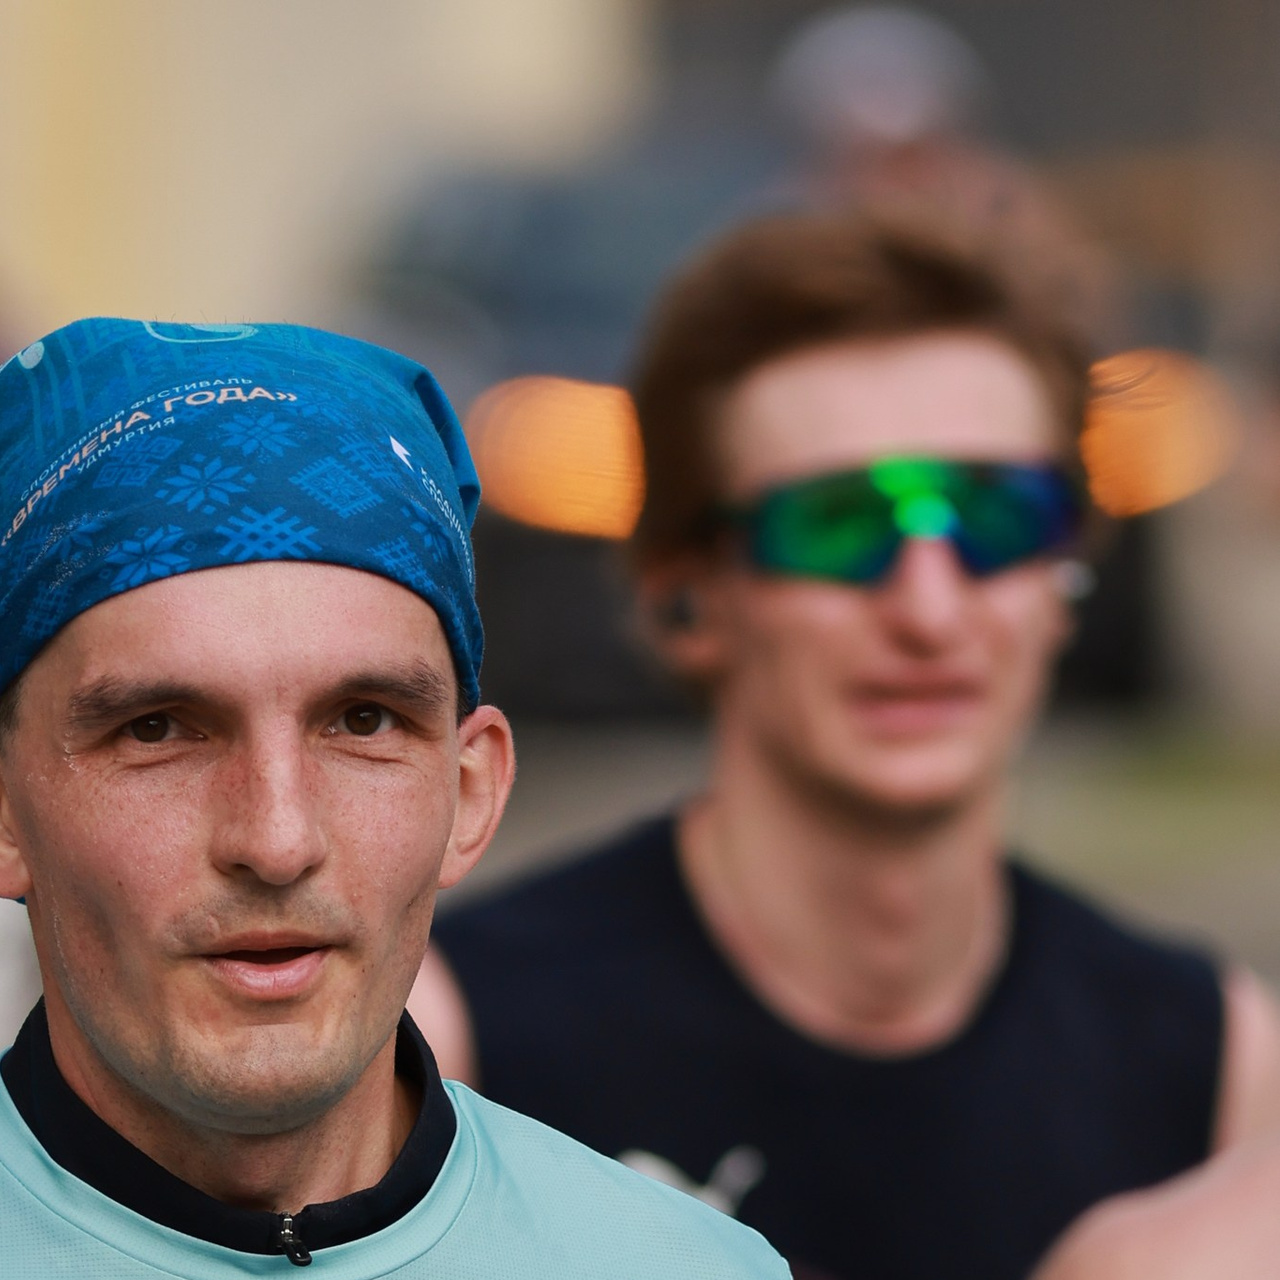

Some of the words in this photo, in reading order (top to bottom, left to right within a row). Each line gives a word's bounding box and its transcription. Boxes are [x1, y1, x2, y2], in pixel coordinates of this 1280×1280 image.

[0, 410, 151, 547] «ВРЕМЕНА
[163, 386, 297, 412] ГОДА»
[20, 410, 125, 501] СПОРТИВНЫЙ
[131, 377, 253, 410] ФЕСТИВАЛЬ
[76, 416, 175, 475] УДМУРТИЯ
